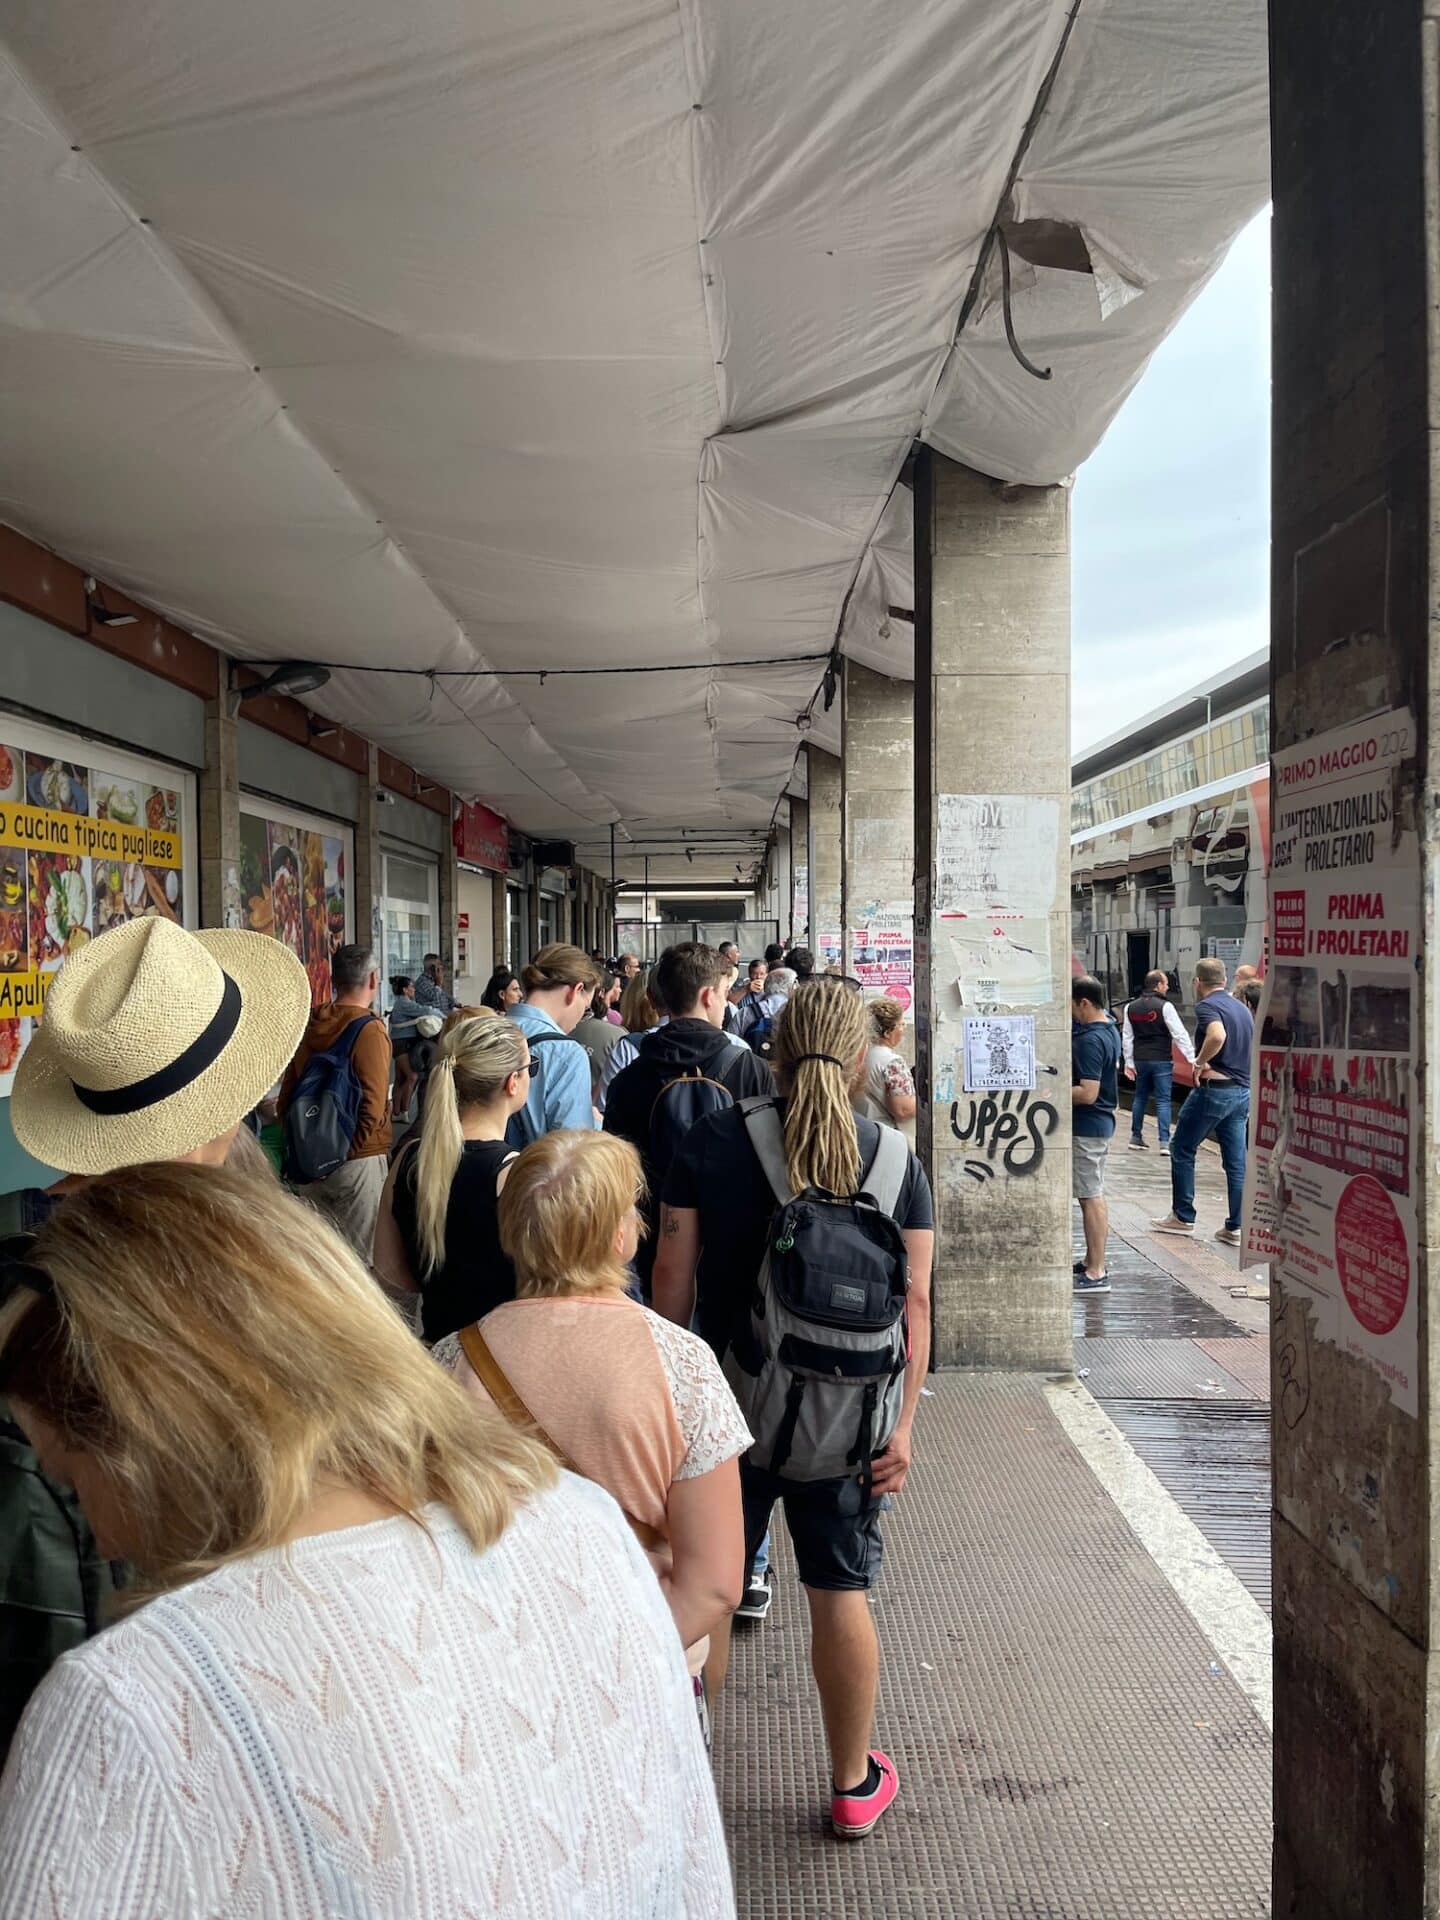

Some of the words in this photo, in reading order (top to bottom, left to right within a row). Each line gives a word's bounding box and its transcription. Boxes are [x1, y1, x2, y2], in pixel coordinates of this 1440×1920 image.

[1319, 738, 1377, 774] MAGGIO
[14, 812, 69, 844] cucina
[75, 820, 117, 855] tipica
[122, 830, 173, 863] pugliese
[1304, 830, 1375, 872] PROLETARIO
[1276, 898, 1303, 912] PRIMO
[1327, 893, 1384, 920] PRIMA
[1307, 929, 1314, 954] I
[1316, 930, 1409, 957] PROLETARI
[0, 974, 45, 1016] Apuli
